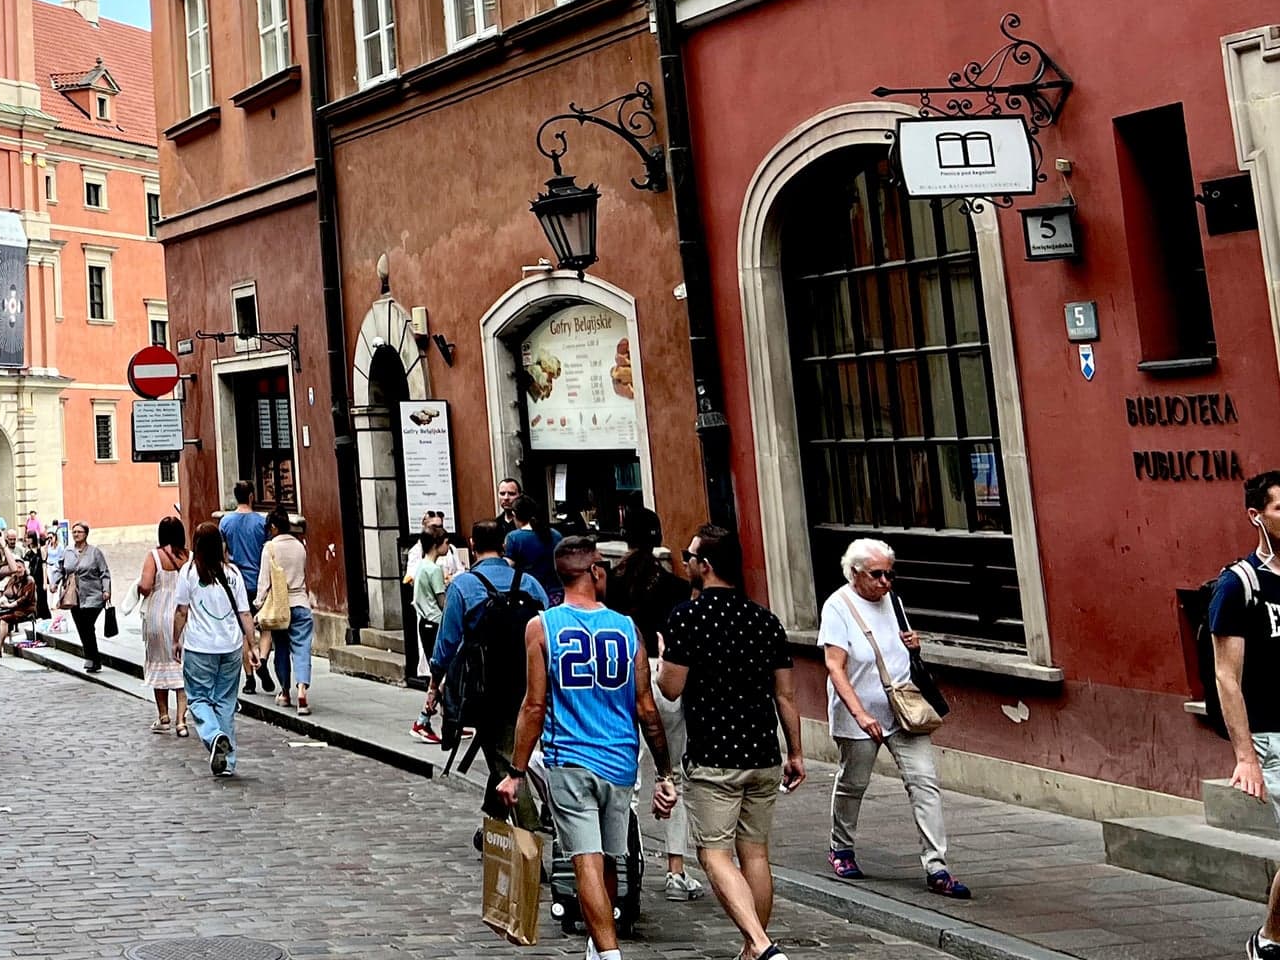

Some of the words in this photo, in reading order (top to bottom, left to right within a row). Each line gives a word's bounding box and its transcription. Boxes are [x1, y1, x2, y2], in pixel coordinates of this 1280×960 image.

[1040, 216, 1057, 239] 5
[549, 319, 572, 336] Gofry
[574, 314, 612, 335] Belgijskie
[1074, 306, 1085, 327] 5
[1125, 393, 1239, 427] BIBLIOTEKA
[1132, 449, 1246, 482] PUBLICZNA
[556, 627, 632, 691] 20
[486, 830, 513, 853] empi
